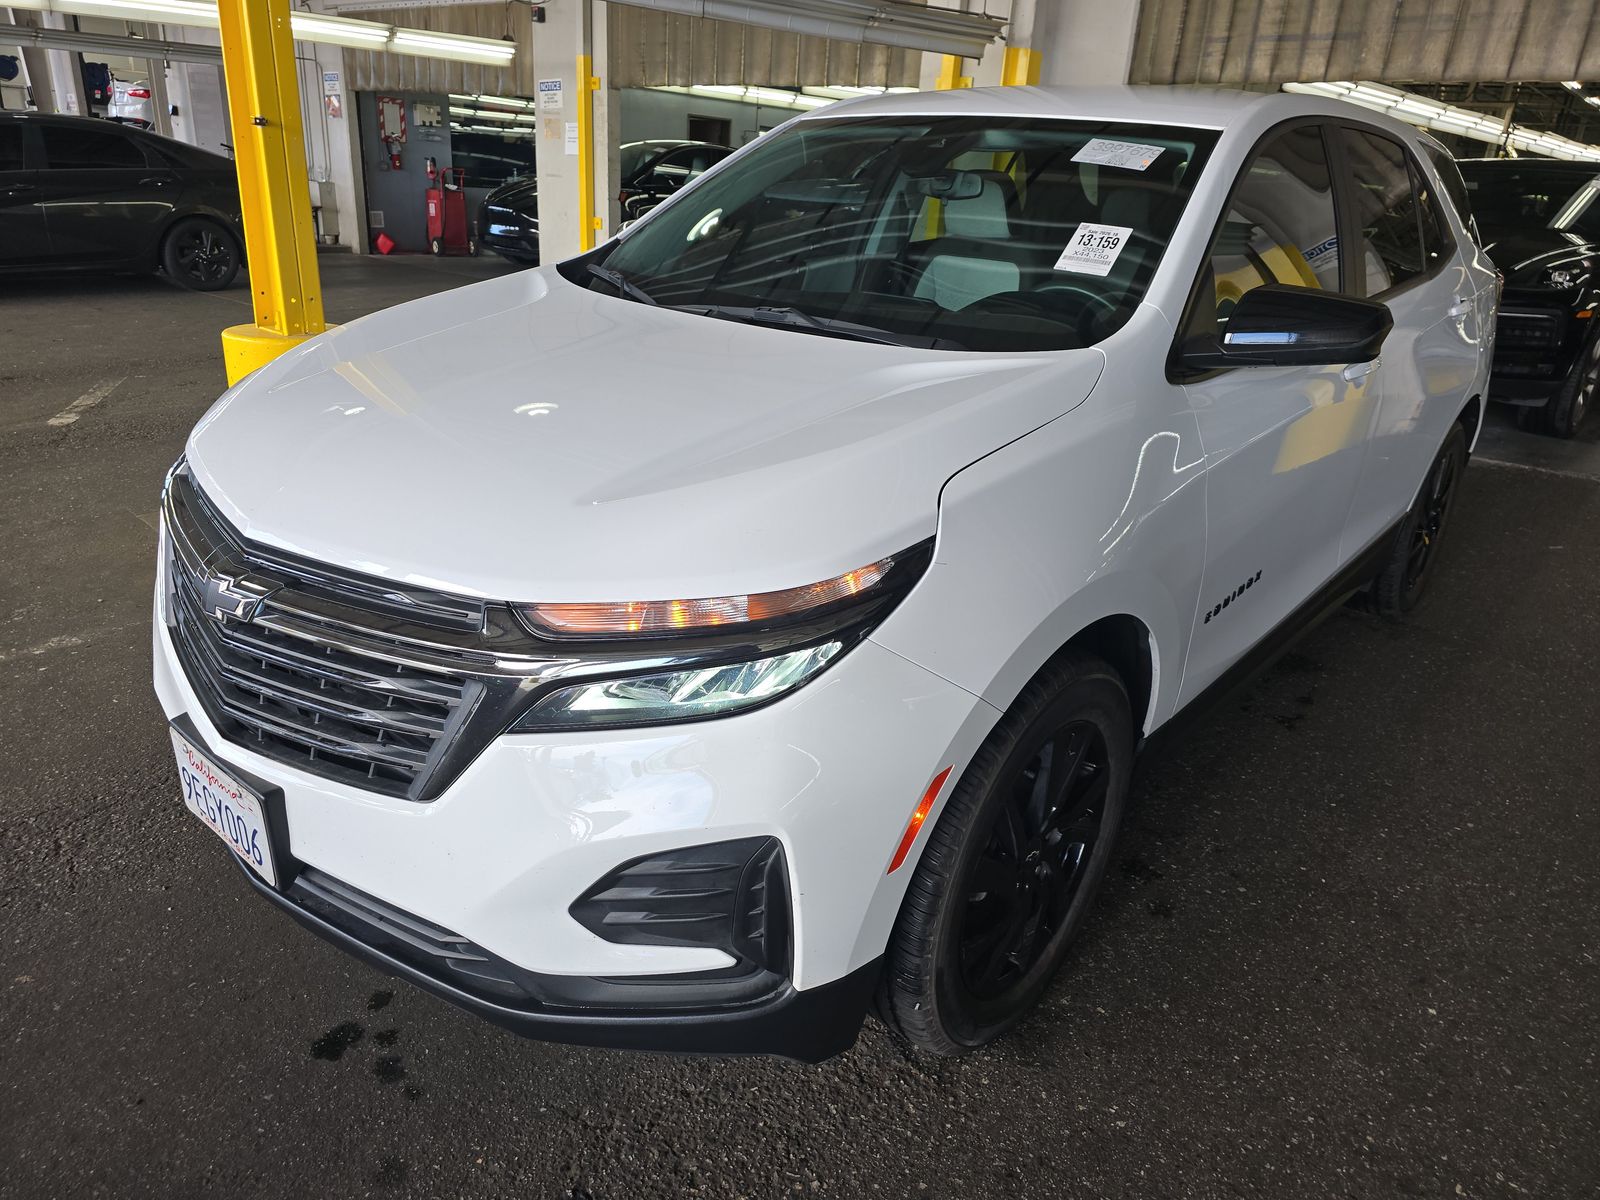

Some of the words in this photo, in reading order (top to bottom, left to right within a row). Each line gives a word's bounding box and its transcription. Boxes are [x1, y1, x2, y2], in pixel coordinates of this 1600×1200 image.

[540, 82, 561, 91] NOTICE
[1091, 141, 1161, 159] 3997679
[1077, 233, 1120, 250] 13:159
[1203, 569, 1263, 625] EQUINOX
[187, 749, 242, 803] California
[181, 766, 263, 866] 9EGY006
